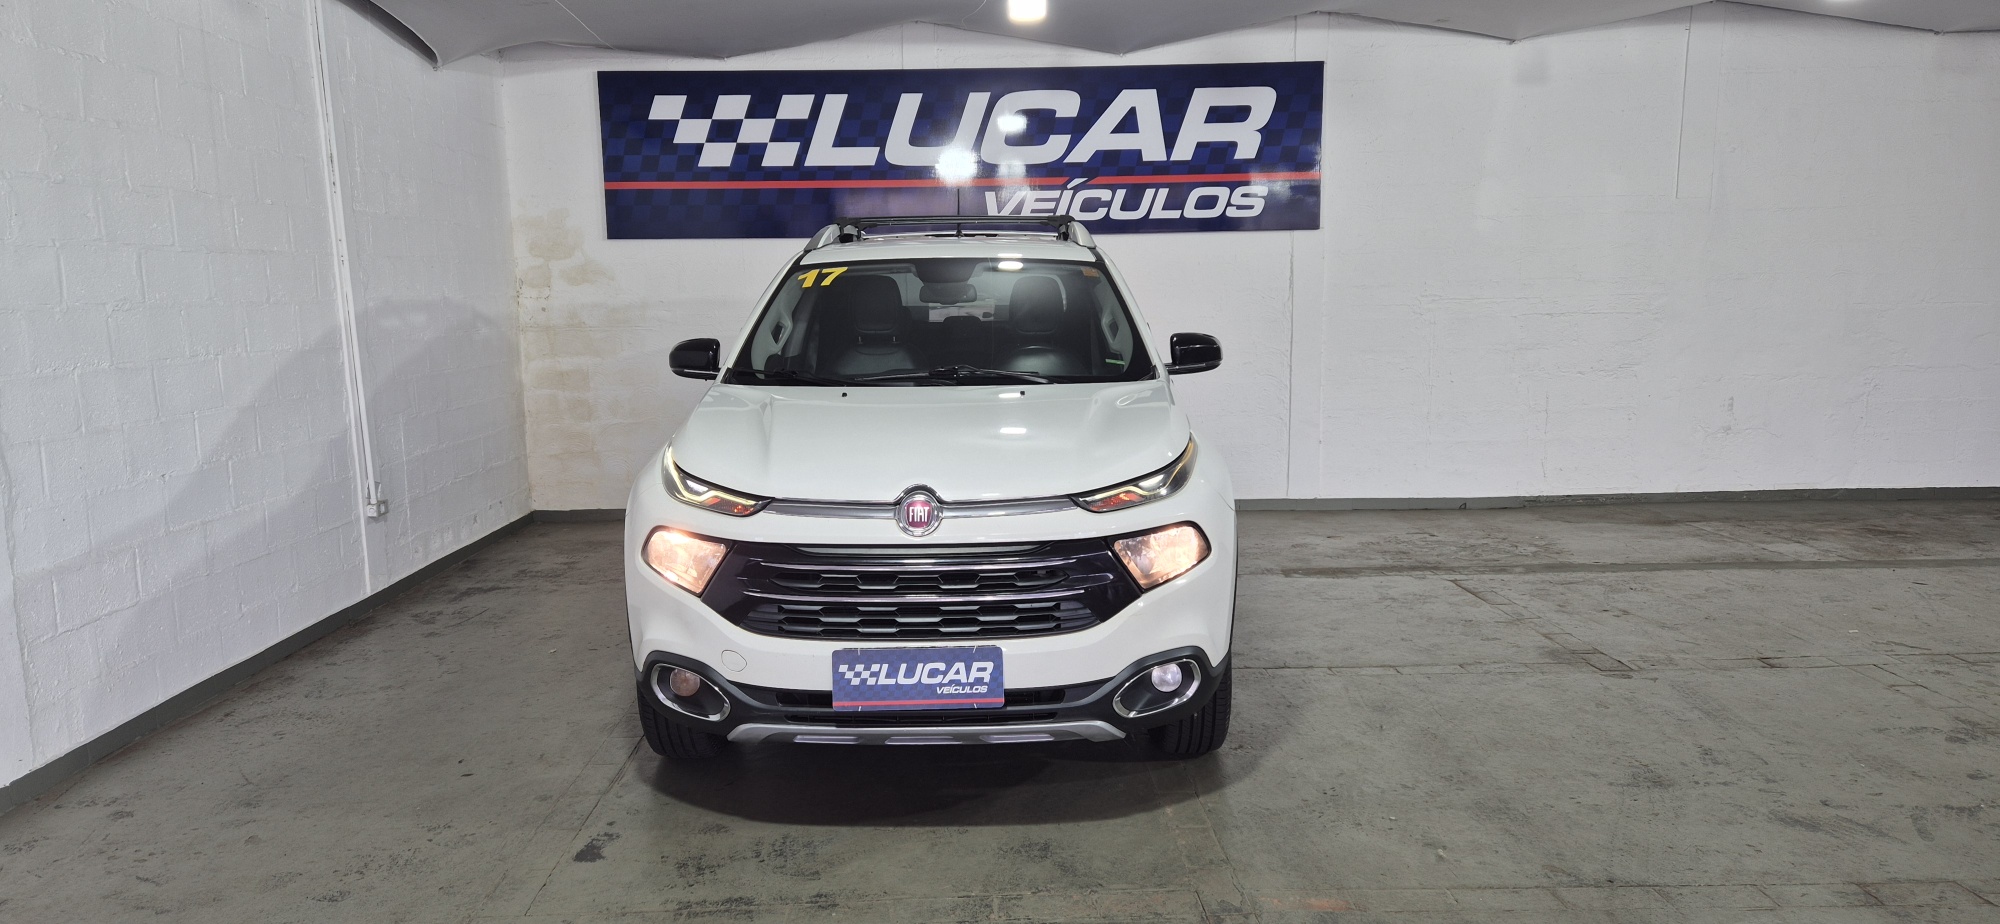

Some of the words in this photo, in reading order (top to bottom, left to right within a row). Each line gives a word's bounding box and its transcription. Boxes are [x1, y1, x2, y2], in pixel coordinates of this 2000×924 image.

[804, 86, 1277, 167] LUCAR
[984, 178, 1269, 221] VEÍCULOS
[797, 266, 849, 288] 17
[909, 506, 930, 523] FIAT
[877, 661, 994, 685] LUCAR
[936, 684, 988, 694] VEÍCULOS
